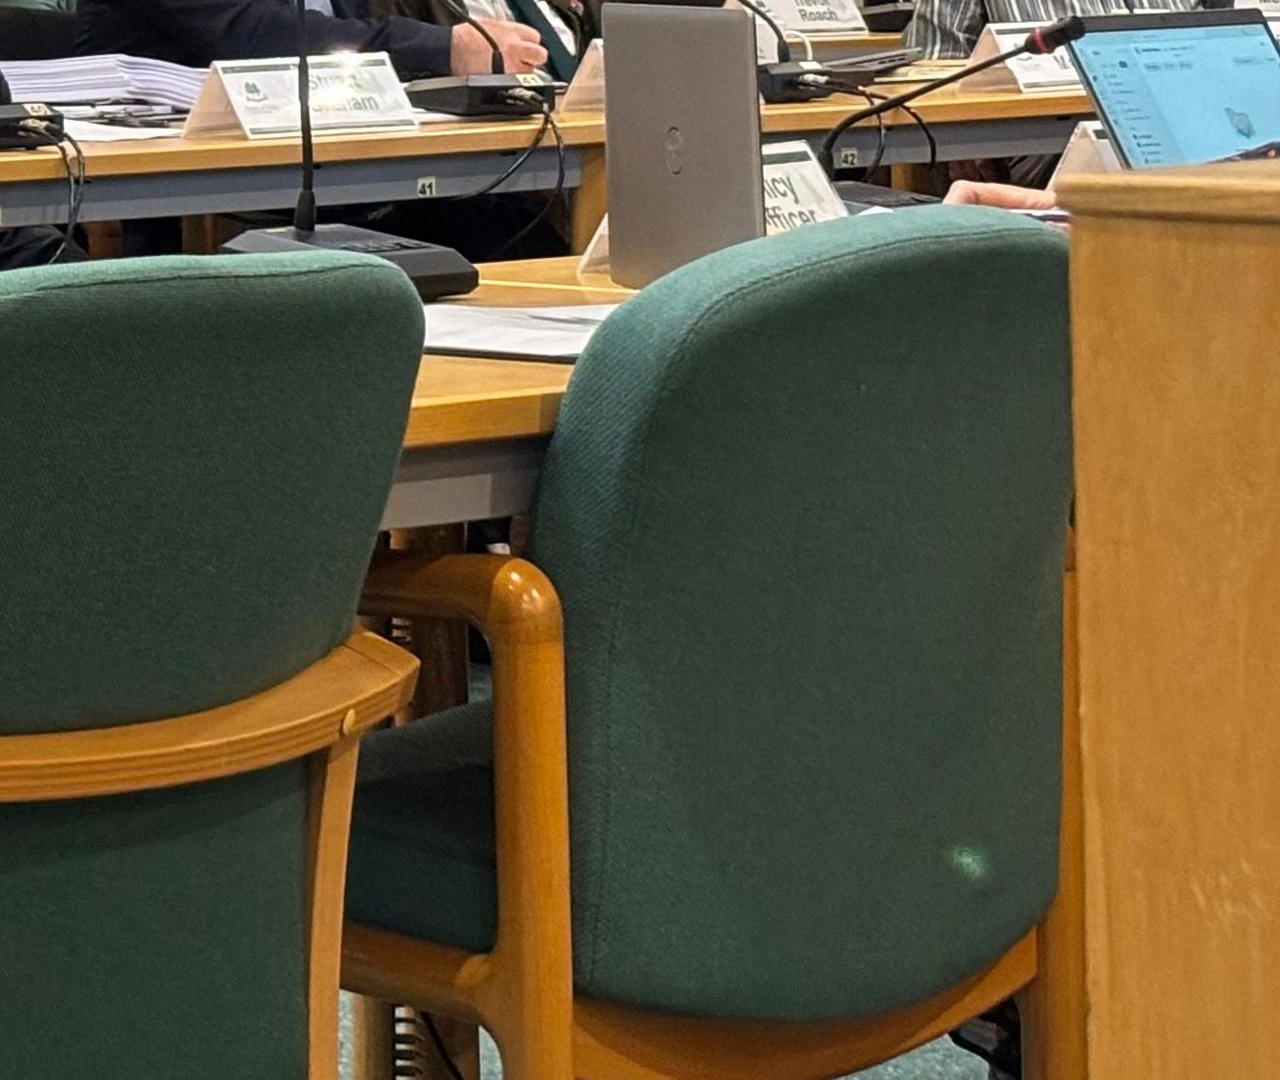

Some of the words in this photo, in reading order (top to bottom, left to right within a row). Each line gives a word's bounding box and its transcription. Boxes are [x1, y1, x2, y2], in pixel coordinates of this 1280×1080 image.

[798, 8, 838, 22] Roach
[842, 152, 856, 166] 42
[418, 182, 433, 196] 41
[765, 205, 817, 229] fficer
